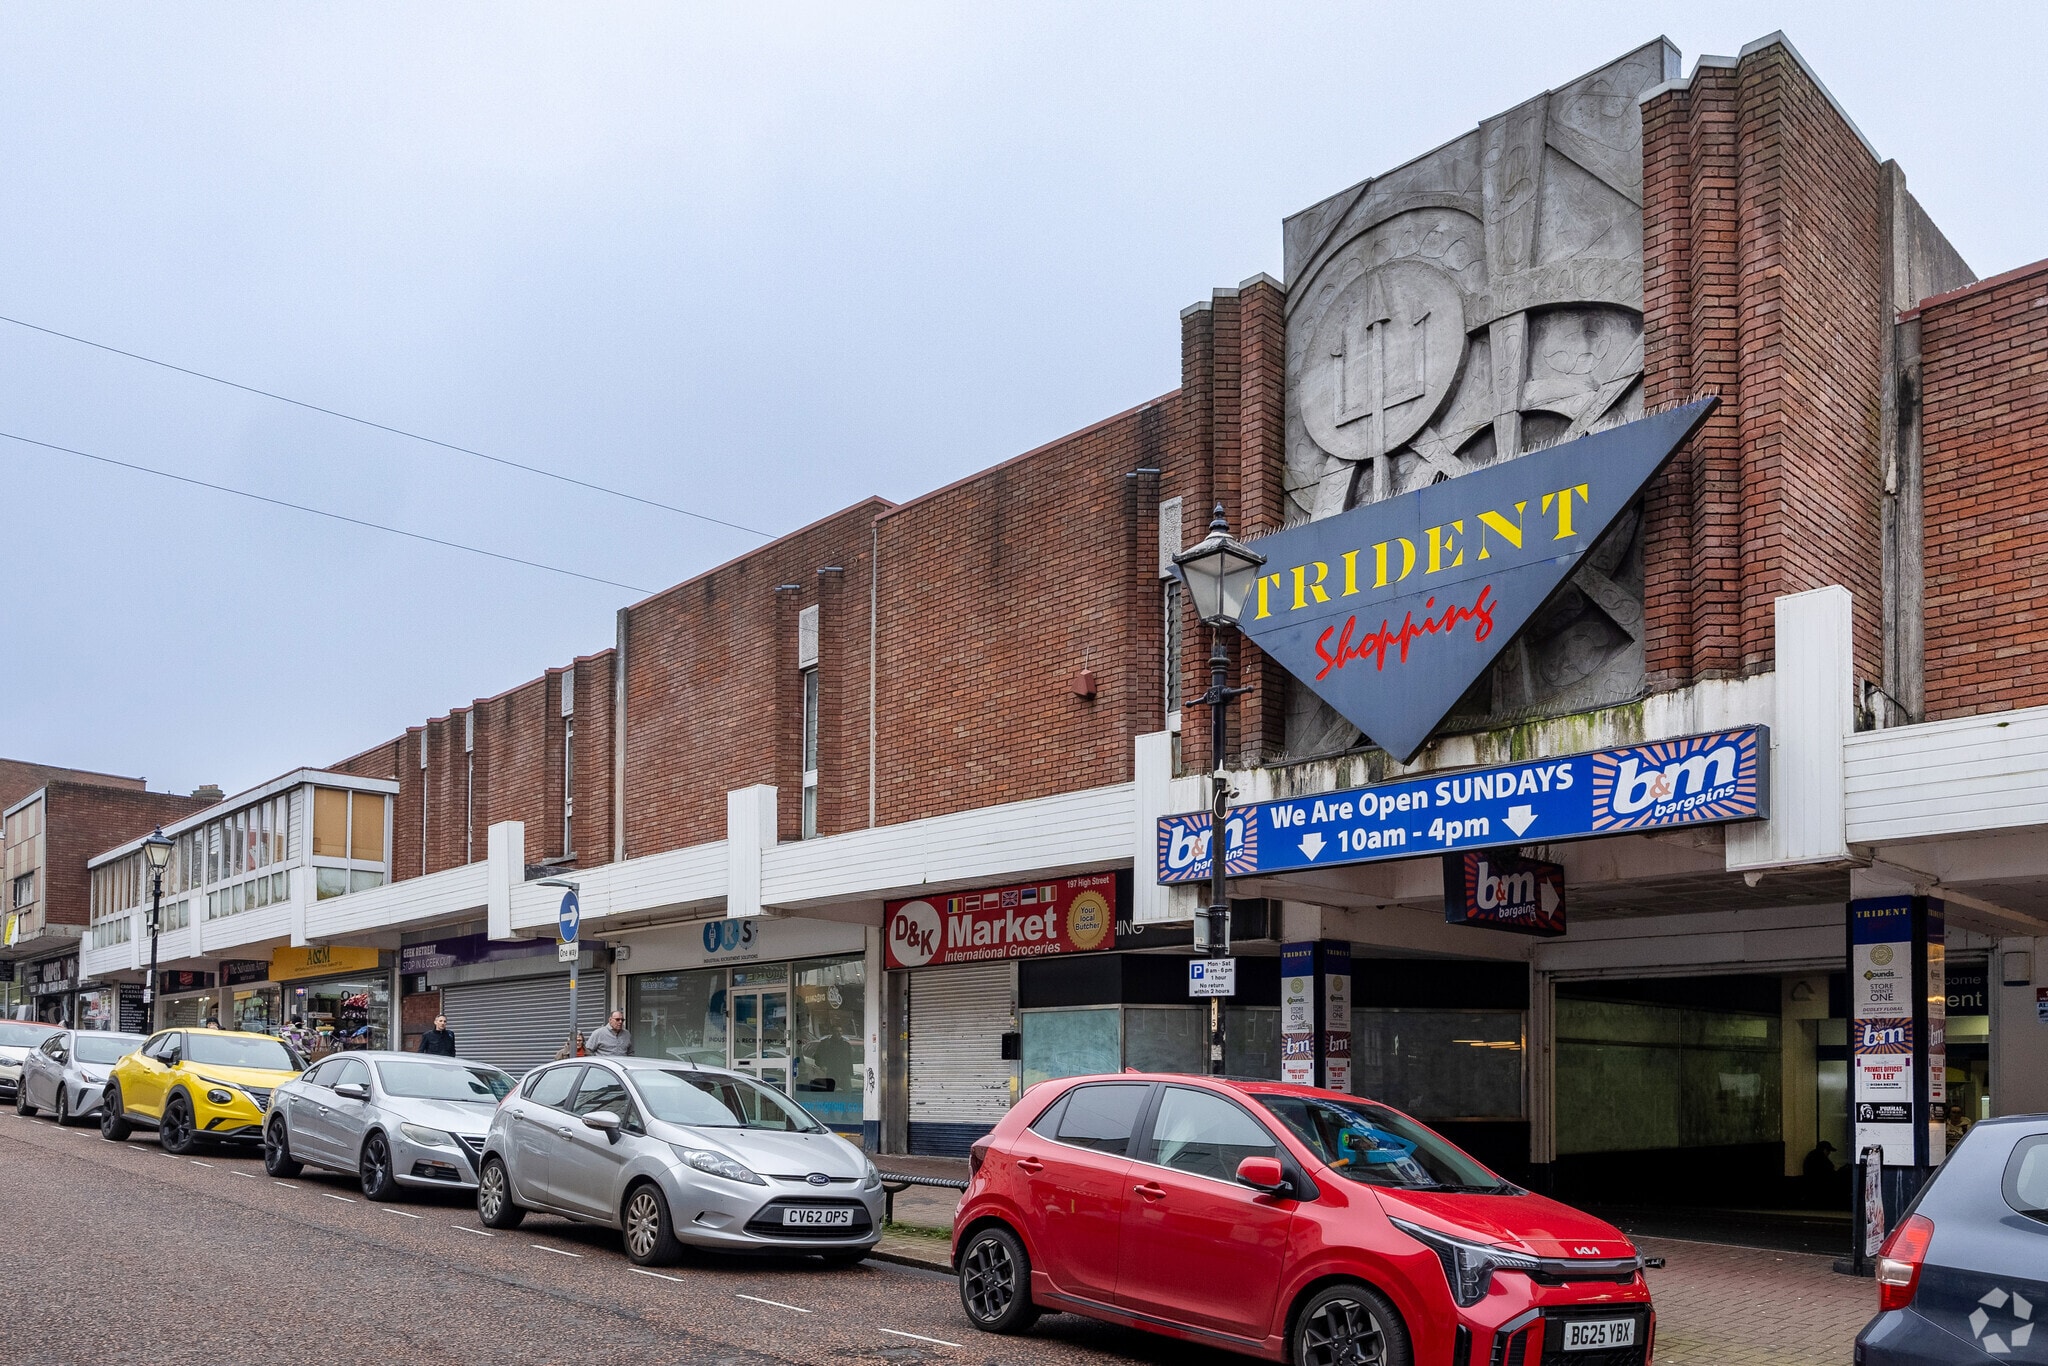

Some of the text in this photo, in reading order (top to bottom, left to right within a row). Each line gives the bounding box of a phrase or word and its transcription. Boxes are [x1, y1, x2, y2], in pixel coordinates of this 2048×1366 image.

[1246, 483, 1589, 621] TRIDENT
[1316, 585, 1498, 681] Shopping
[1613, 746, 1738, 815] b&m
[1270, 763, 1574, 829] We Are Open SUNDAYS
[1654, 784, 1736, 817] bargains
[1338, 827, 1406, 852] 10am
[1428, 816, 1490, 846] 4pm
[1194, 848, 1244, 872] barins
[1067, 876, 1110, 888] 197 High Street
[1477, 861, 1536, 910] b&m
[1081, 914, 1096, 922] local
[1499, 903, 1536, 918] bargains
[1856, 907, 1908, 918] TRIDENT
[895, 915, 934, 956] D&K
[948, 905, 1058, 948] Market
[1075, 923, 1100, 931] Butcher
[403, 944, 437, 958] GEEK RETREAT
[560, 949, 577, 957] One way
[945, 941, 1061, 962] International Groceries
[1283, 950, 1311, 958] TRIDENT
[402, 961, 415, 970] STOP
[426, 957, 440, 967] GEEK
[1870, 993, 1894, 1001] ONE
[1291, 1013, 1304, 1021] ONE
[1863, 1024, 1905, 1047] b&m
[789, 1210, 848, 1223] CV62 OPS
[1570, 1322, 1630, 1346] BG25 YBX
